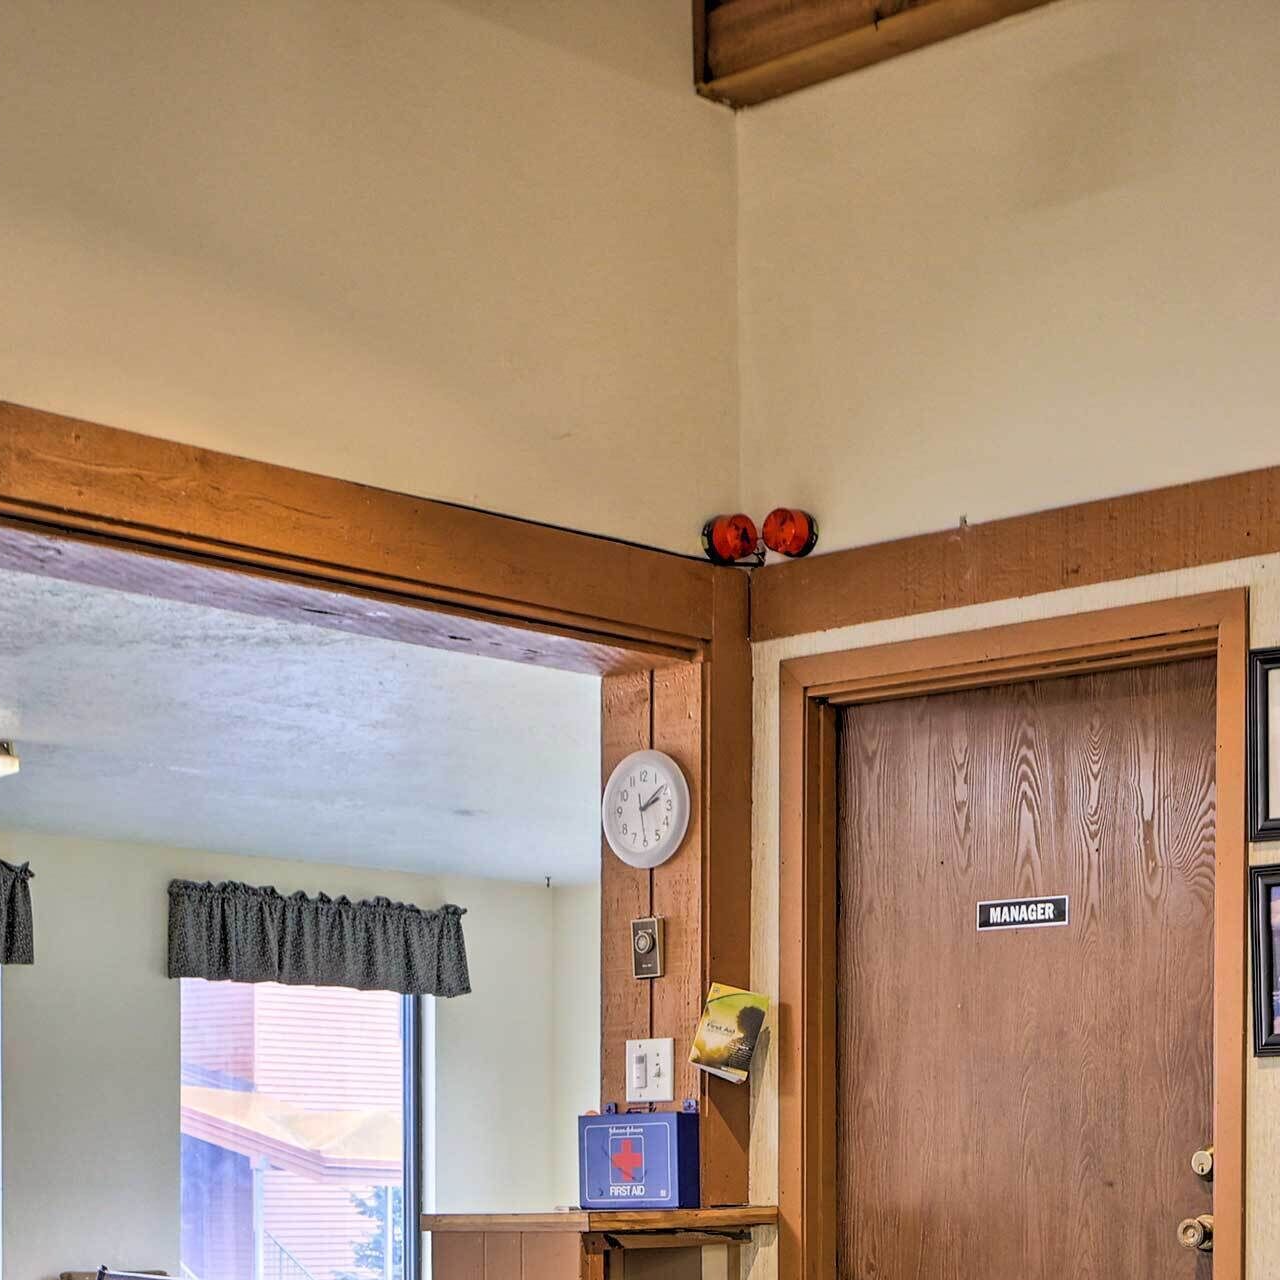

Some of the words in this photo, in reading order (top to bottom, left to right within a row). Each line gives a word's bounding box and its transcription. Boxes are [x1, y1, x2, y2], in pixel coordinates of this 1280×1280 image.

[629, 775, 636, 788] 11
[640, 769, 648, 783] 12
[621, 789, 629, 802] 10
[617, 806, 623, 818] 9
[666, 800, 673, 812] 3
[663, 815, 670, 829] 4
[622, 823, 628, 836] 8
[655, 829, 661, 842] 5
[632, 832, 637, 844] 7
[989, 903, 1055, 923] MANAGER
[610, 1186, 631, 1196] FIRST
[631, 1185, 645, 1196] AID
